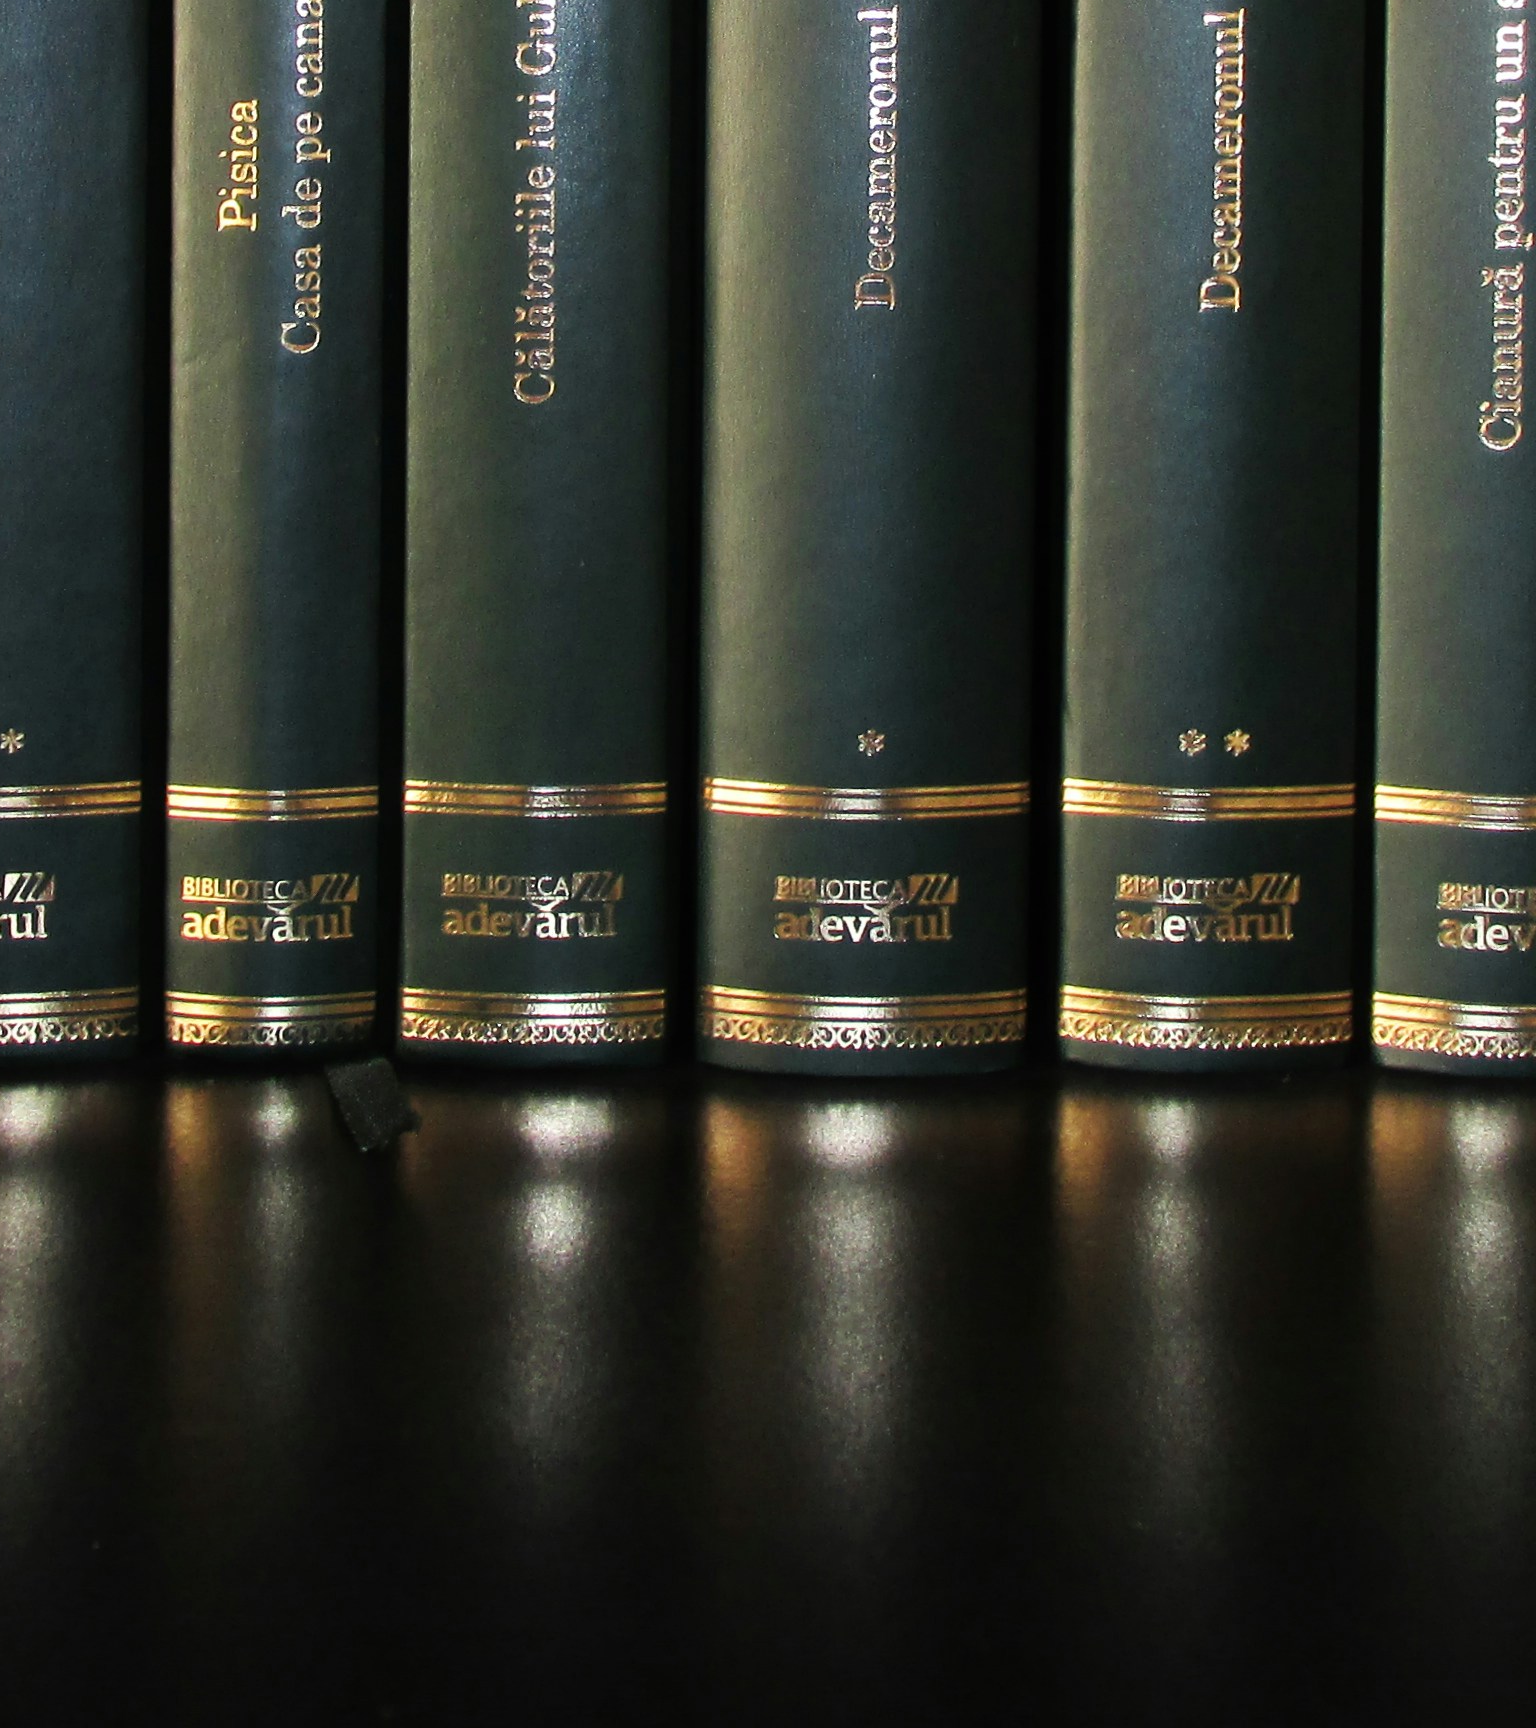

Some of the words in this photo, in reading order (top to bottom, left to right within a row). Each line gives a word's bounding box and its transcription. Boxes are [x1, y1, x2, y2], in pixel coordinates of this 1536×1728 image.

[1495, 20, 1526, 82] un
[218, 99, 257, 232] Pisica
[291, 105, 331, 164] pe
[515, 89, 556, 152] lui
[855, 5, 898, 310] Decameronul
[1199, 8, 1245, 313] Decameronul
[1487, 93, 1534, 251] pentru
[281, 178, 322, 228] de
[280, 244, 321, 354] Casa
[1479, 262, 1523, 451] Cianură
[180, 875, 309, 900] BIBLIOTECA
